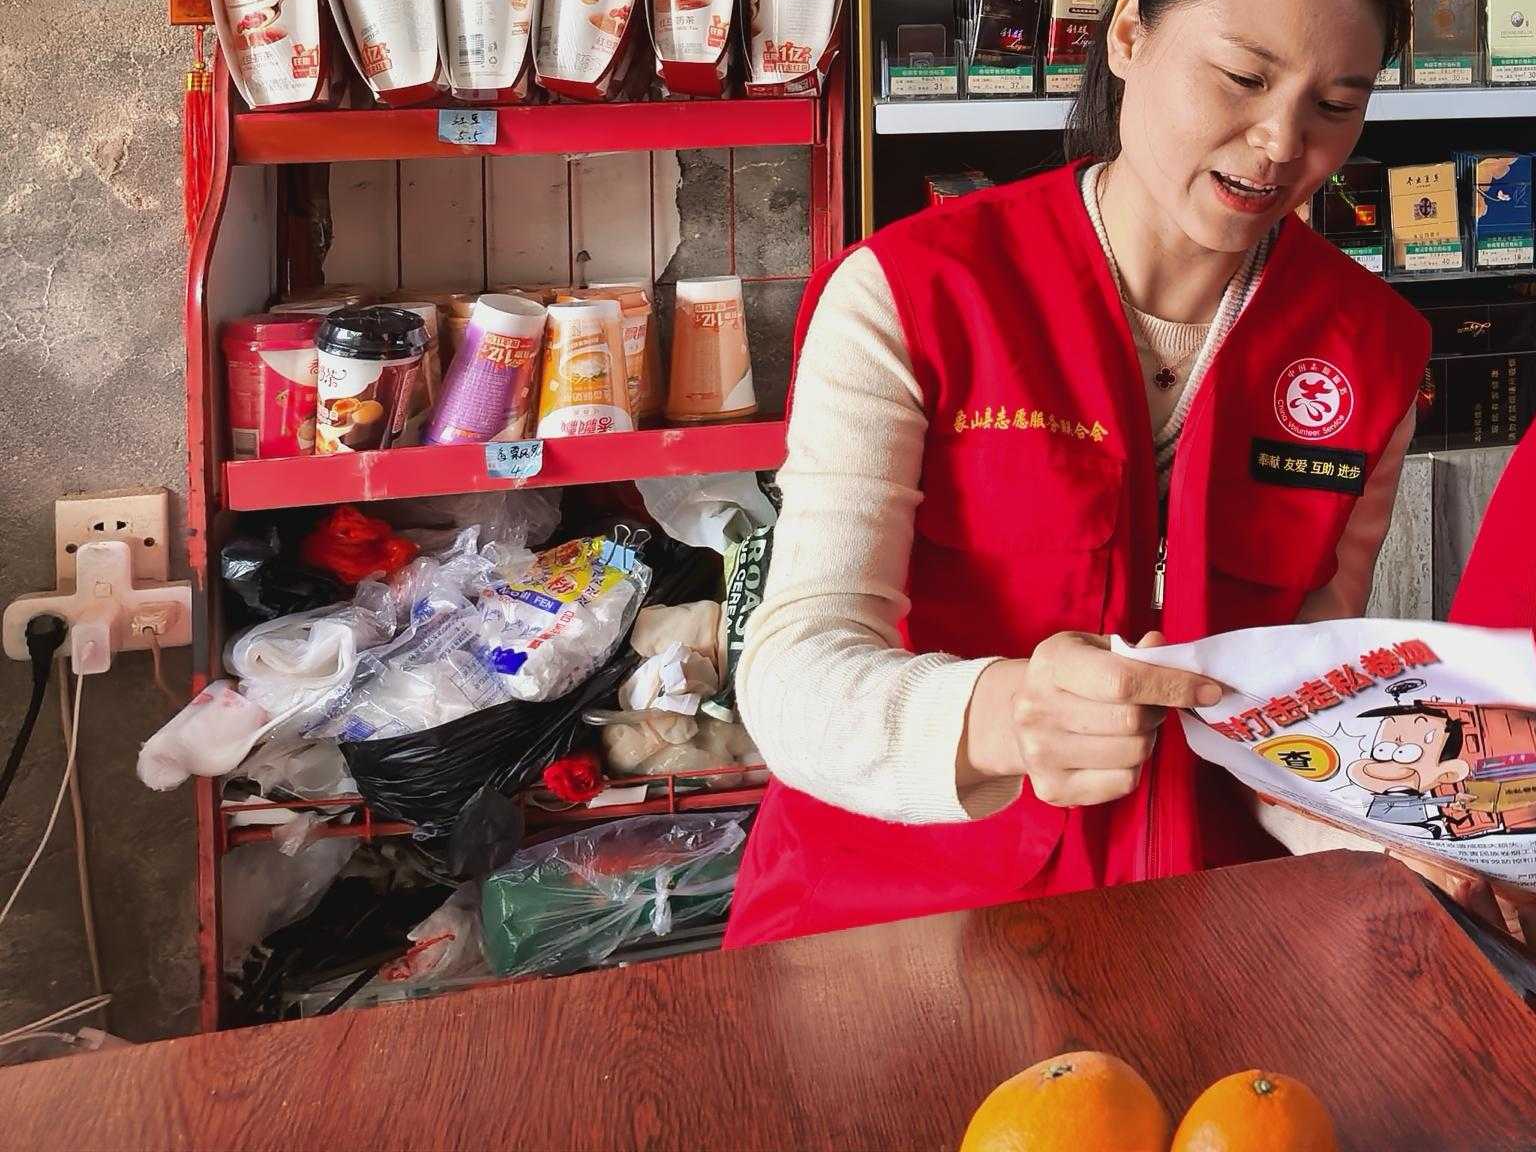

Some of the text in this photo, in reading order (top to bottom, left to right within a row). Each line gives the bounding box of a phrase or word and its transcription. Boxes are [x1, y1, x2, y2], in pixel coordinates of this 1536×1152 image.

[451, 113, 481, 126] 红豆
[456, 130, 482, 143] 5.5
[953, 406, 1108, 443] 象山县志愿服务联合会
[1323, 414, 1345, 434] Service
[1284, 457, 1308, 474] 友爱
[1311, 461, 1335, 477] 互助
[1337, 463, 1361, 480] 进步
[1210, 639, 1443, 742] 打击走私卷烟
[1279, 750, 1317, 772] 查
